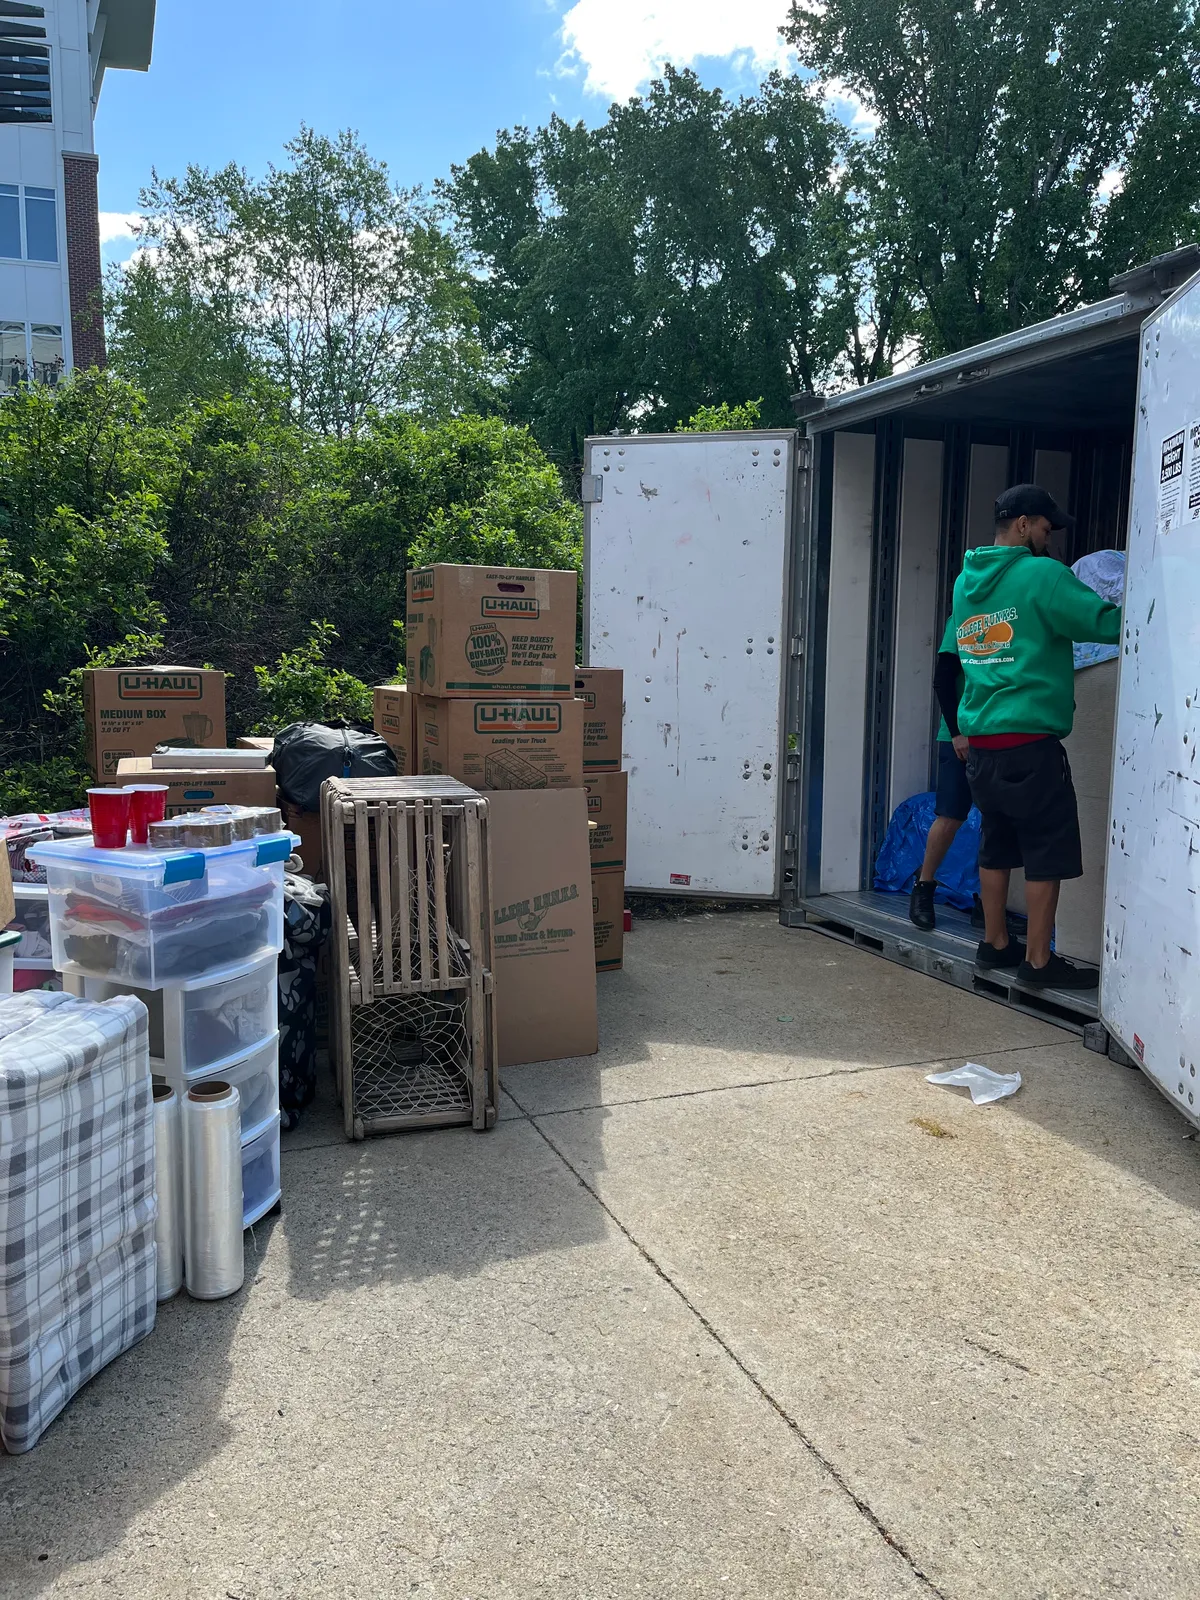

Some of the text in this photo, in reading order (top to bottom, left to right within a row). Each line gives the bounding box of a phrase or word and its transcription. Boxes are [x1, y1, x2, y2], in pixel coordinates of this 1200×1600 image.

[1163, 448, 1182, 467] WEIGHT
[485, 600, 536, 611] U-HAUL
[471, 633, 501, 649] 100%
[469, 647, 506, 660] BUY-BACK
[124, 677, 197, 689] U-HAUL
[100, 710, 166, 719] MEDIUM BOX
[481, 708, 556, 722] U-HAUL
[494, 899, 530, 926] LLEGE
[539, 930, 546, 939] &
